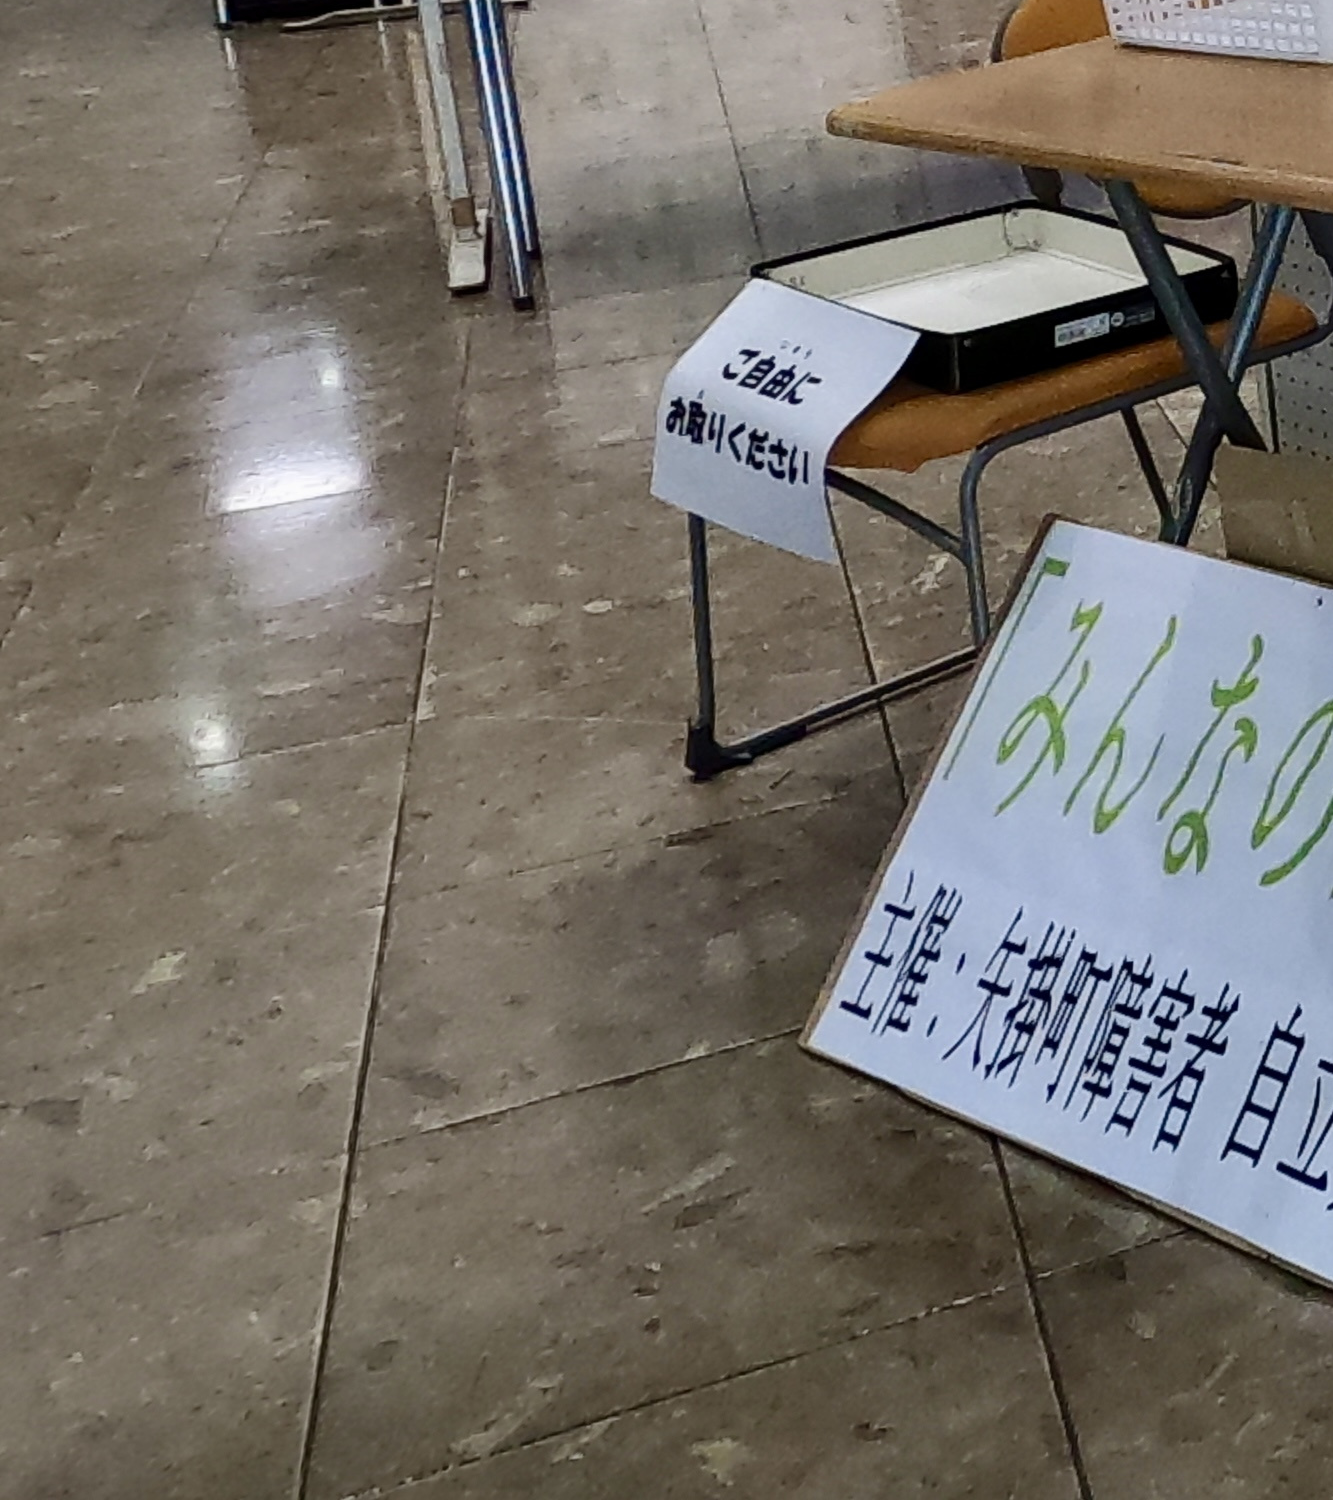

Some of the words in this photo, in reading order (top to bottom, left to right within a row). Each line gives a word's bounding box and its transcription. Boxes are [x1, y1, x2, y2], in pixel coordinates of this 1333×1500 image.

[722, 348, 823, 405] ご自由に
[665, 396, 809, 485] お取りください
